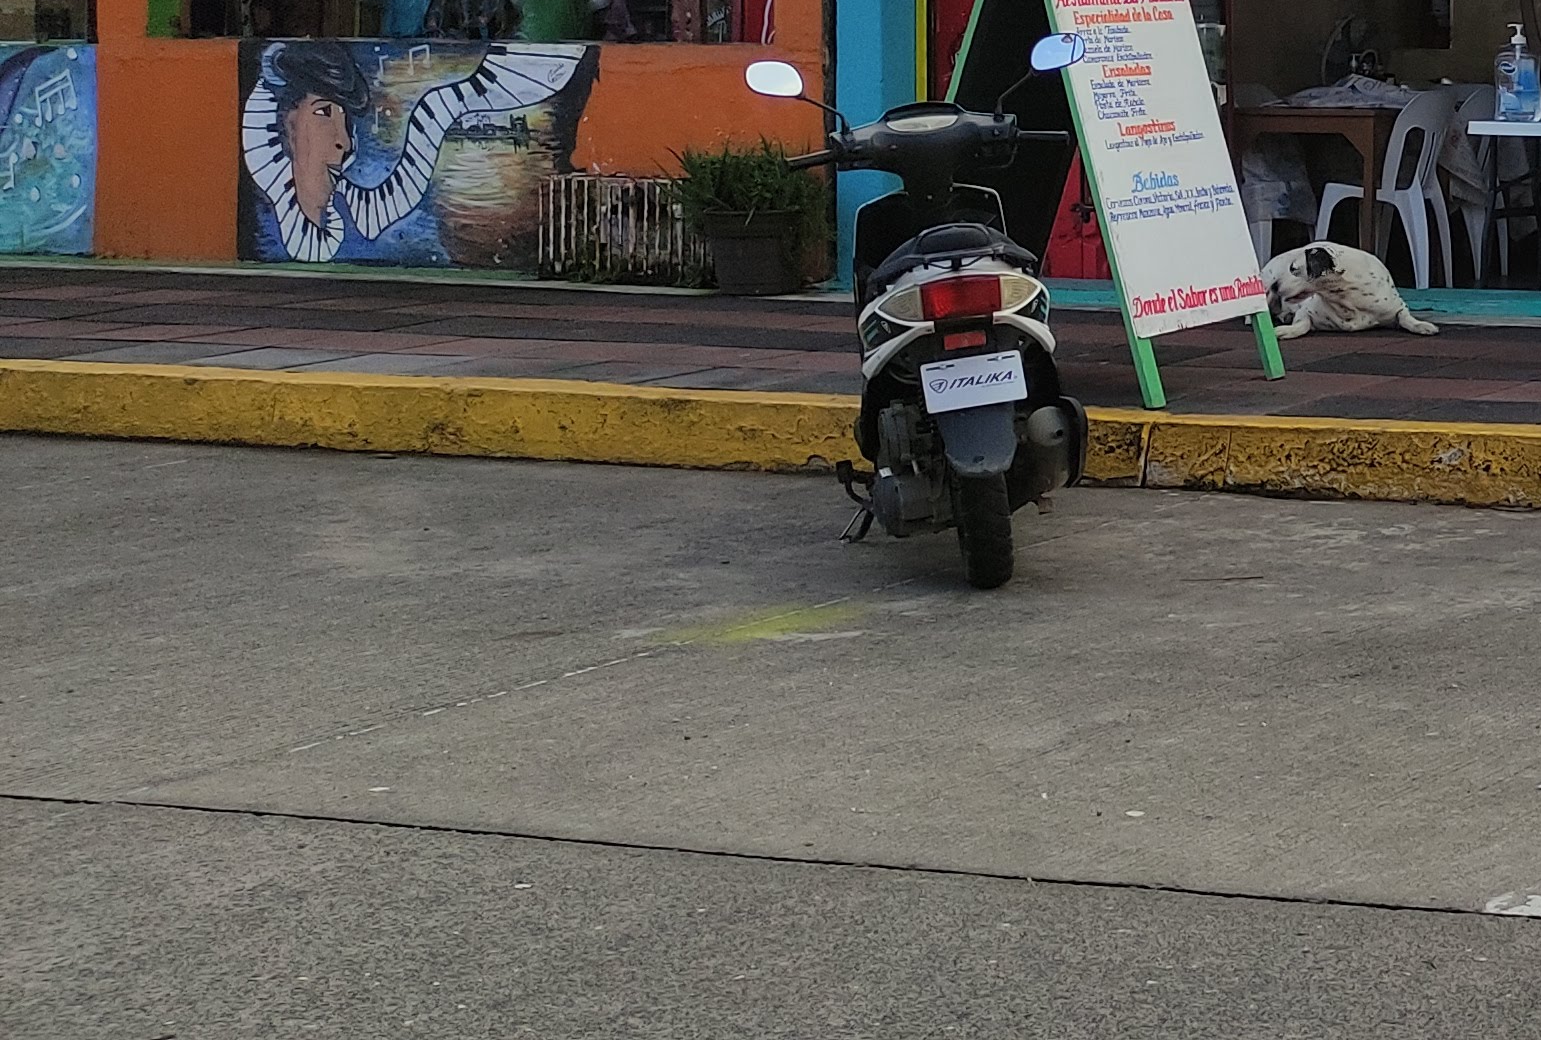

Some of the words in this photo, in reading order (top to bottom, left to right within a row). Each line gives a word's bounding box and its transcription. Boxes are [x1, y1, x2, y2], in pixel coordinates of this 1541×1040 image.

[1152, 5, 1174, 20] Casa
[1102, 63, 1152, 78] Ensaladas
[1131, 171, 1179, 193] Bebidas
[1133, 293, 1165, 319] Donde
[1168, 289, 1178, 312] el
[1178, 285, 1207, 310] Sabor
[1209, 287, 1218, 304] es
[1219, 285, 1235, 301] una
[950, 370, 1013, 389] ITALIKA
